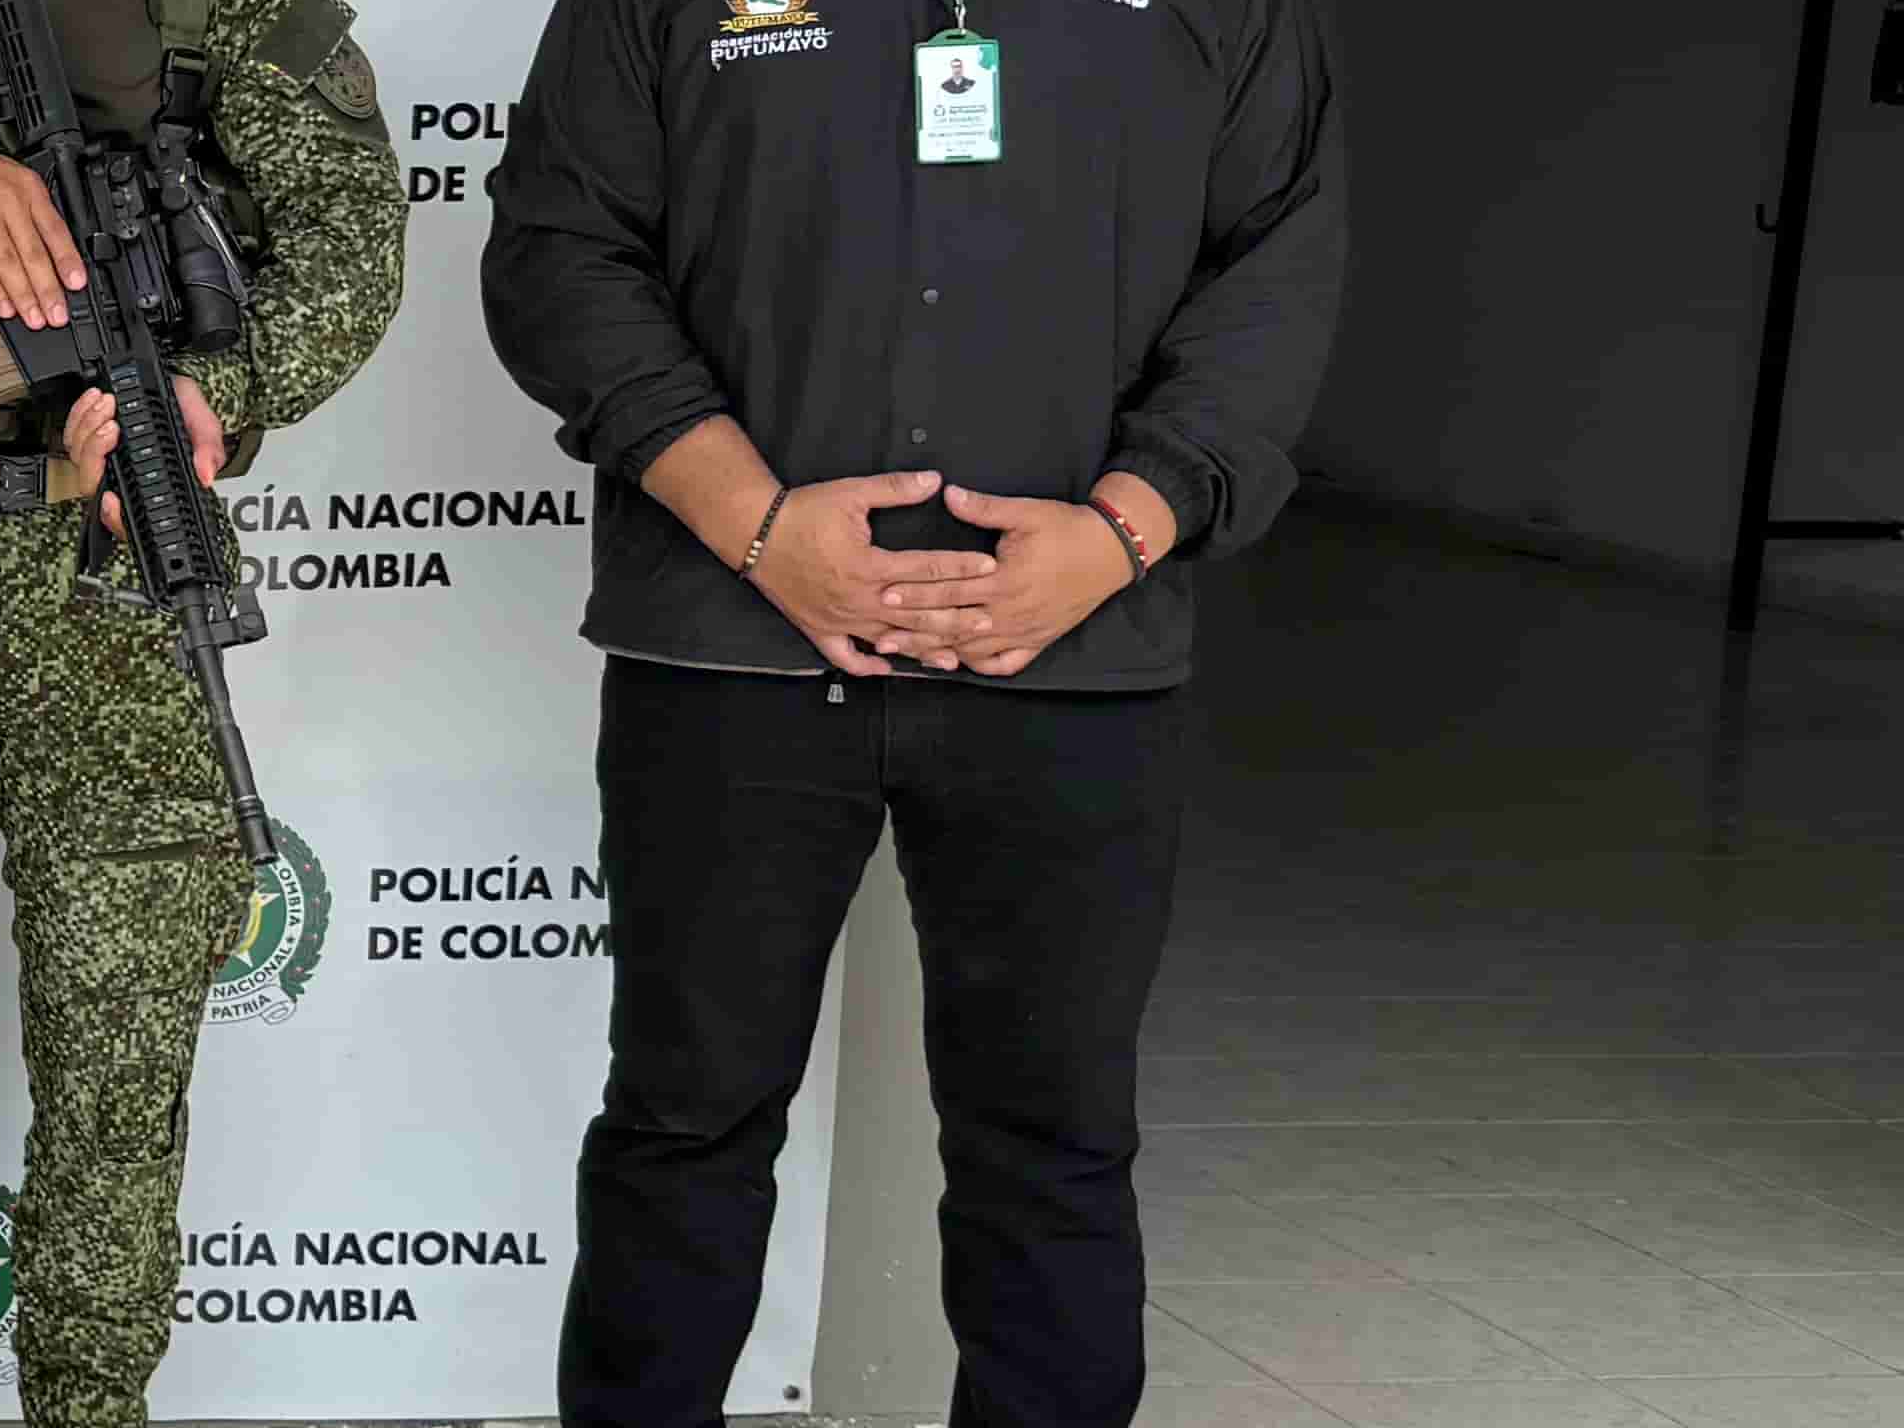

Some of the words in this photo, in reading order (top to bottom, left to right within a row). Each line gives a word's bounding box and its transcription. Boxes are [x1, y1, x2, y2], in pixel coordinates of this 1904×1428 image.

[711, 36, 828, 61] PUTUMAYO
[409, 166, 469, 204] DE
[328, 490, 586, 530] NACIONAL
[238, 551, 452, 593] OLOMBIA
[370, 854, 553, 903] POLICÍA
[367, 926, 424, 960] DE
[441, 919, 610, 962] COLOM
[184, 1220, 271, 1271] ICÍA
[295, 1230, 547, 1266] NACIONAL
